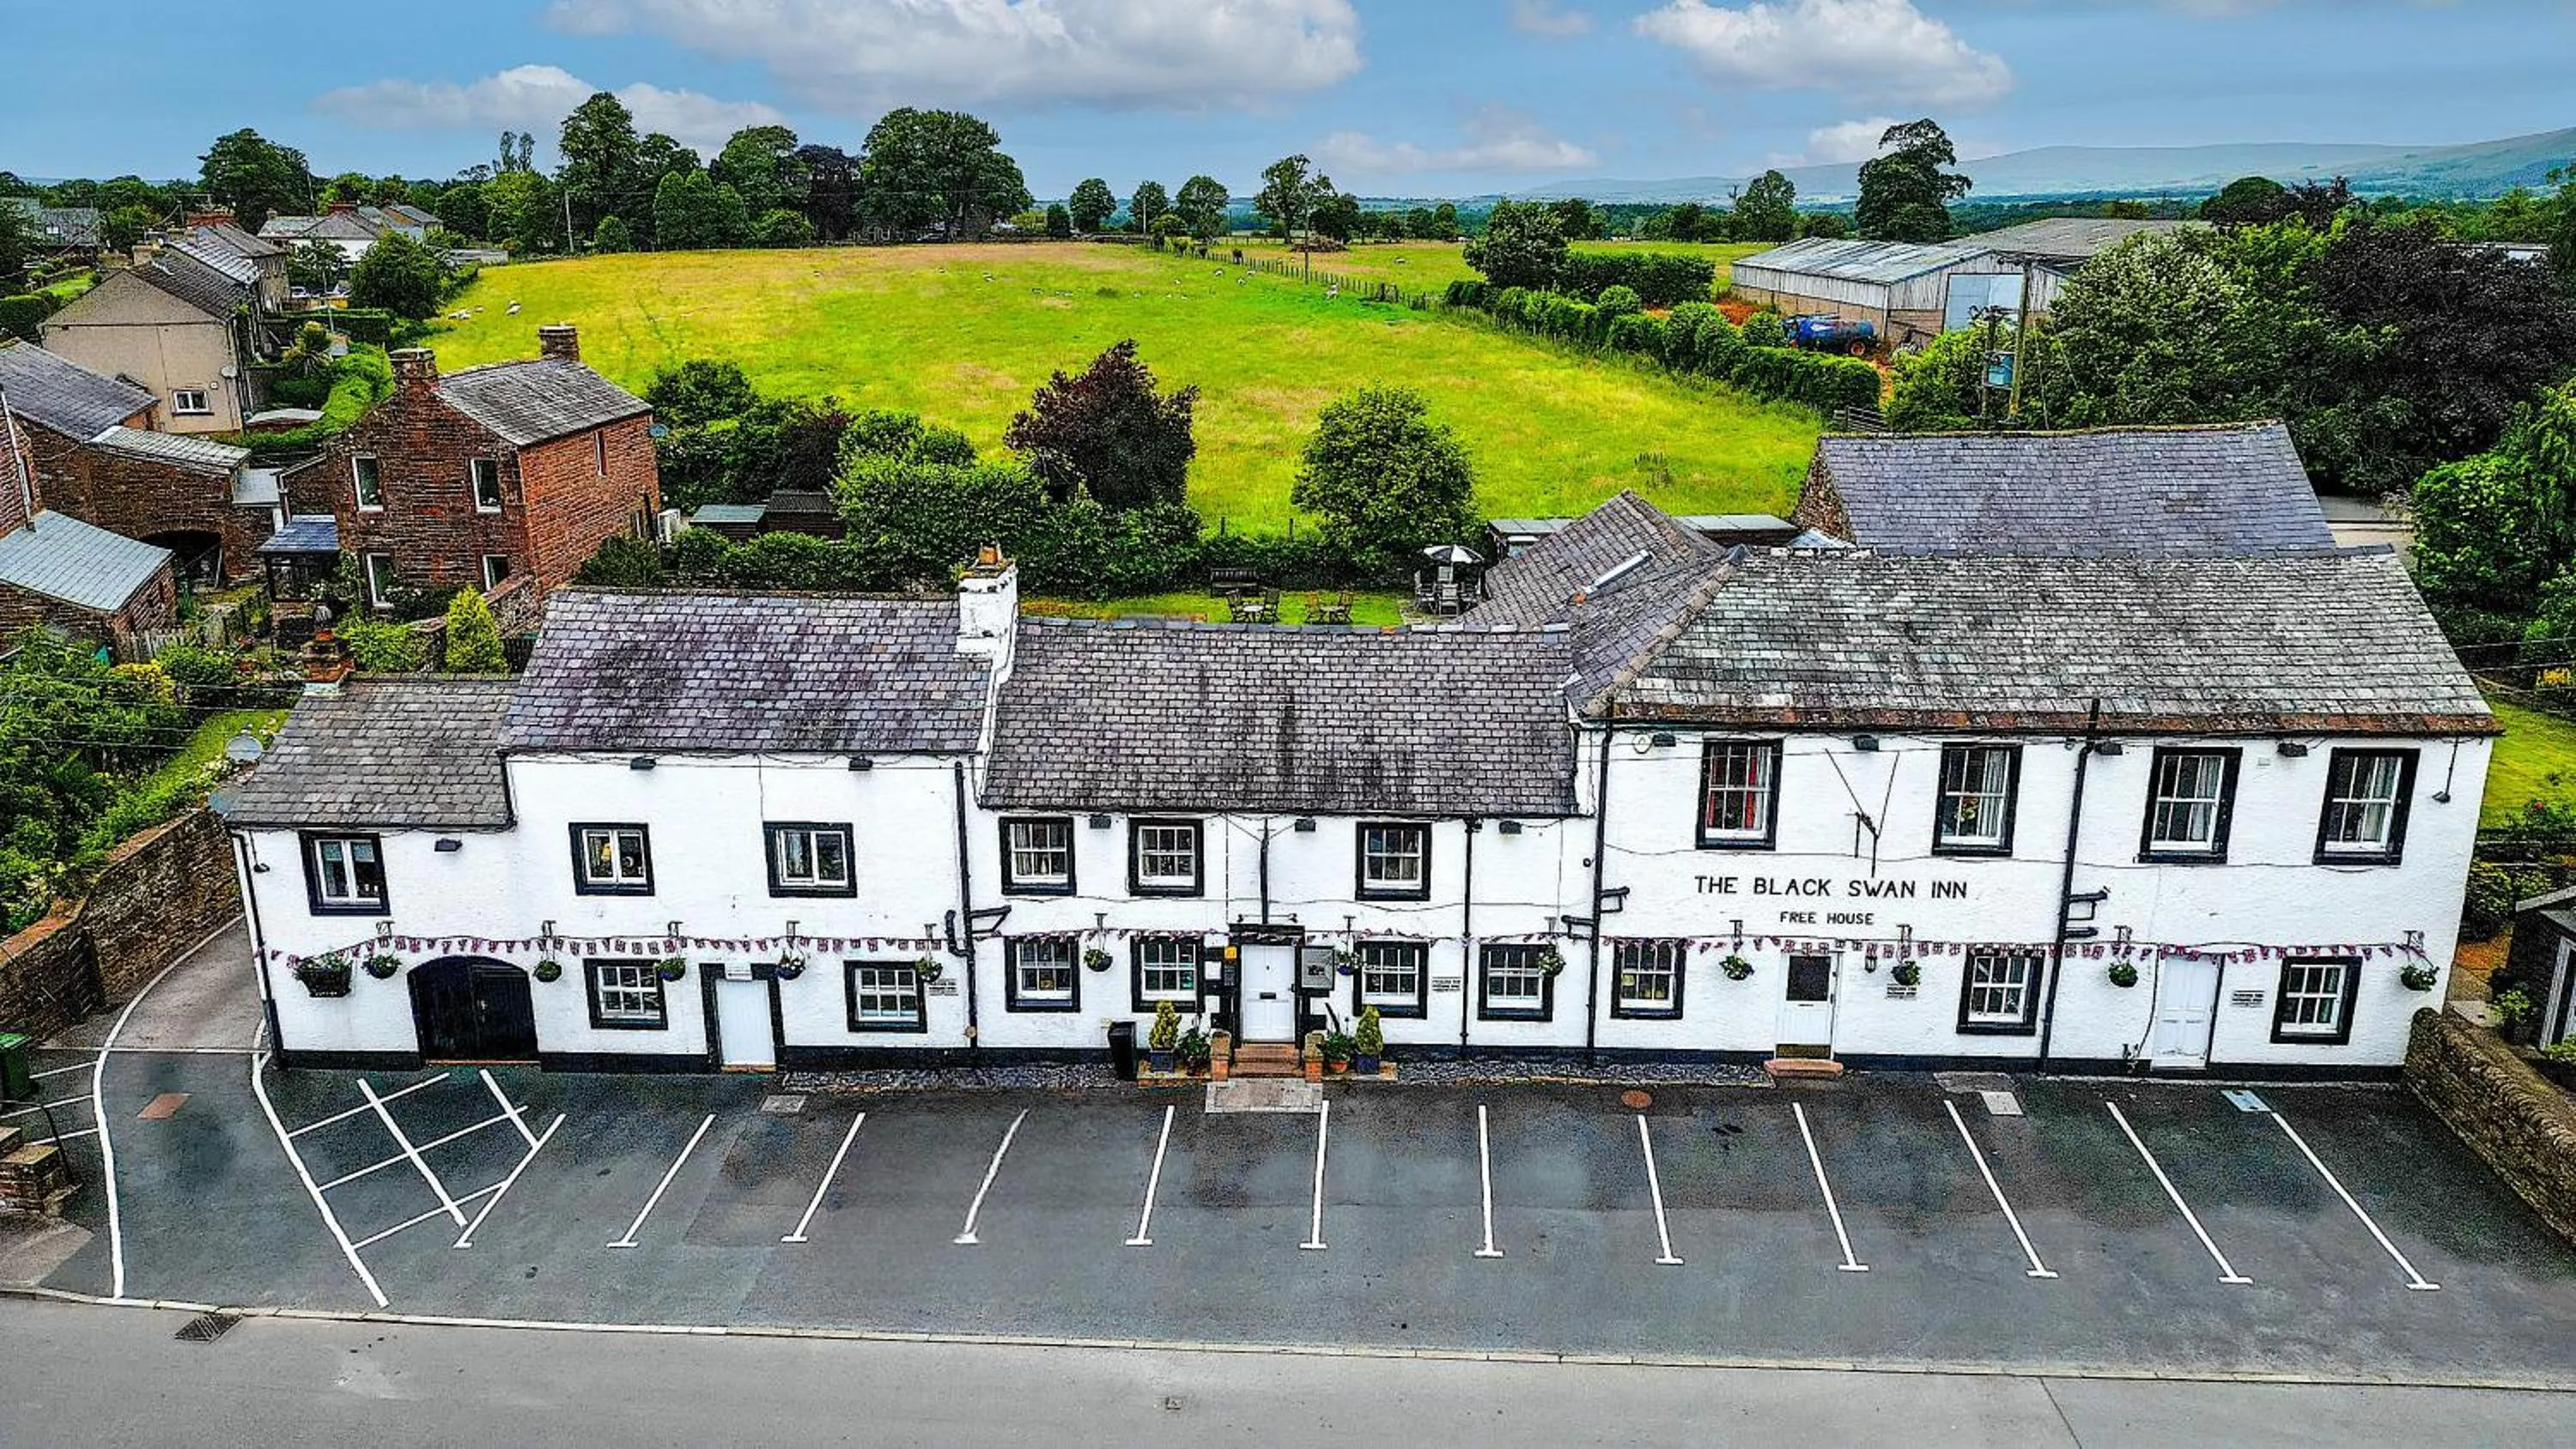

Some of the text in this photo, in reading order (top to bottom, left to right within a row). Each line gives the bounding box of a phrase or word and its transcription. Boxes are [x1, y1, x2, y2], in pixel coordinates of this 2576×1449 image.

[1694, 876, 1967, 900] THE BLACK SWAN INN
[1780, 911, 1874, 925] FREE HOUSE
